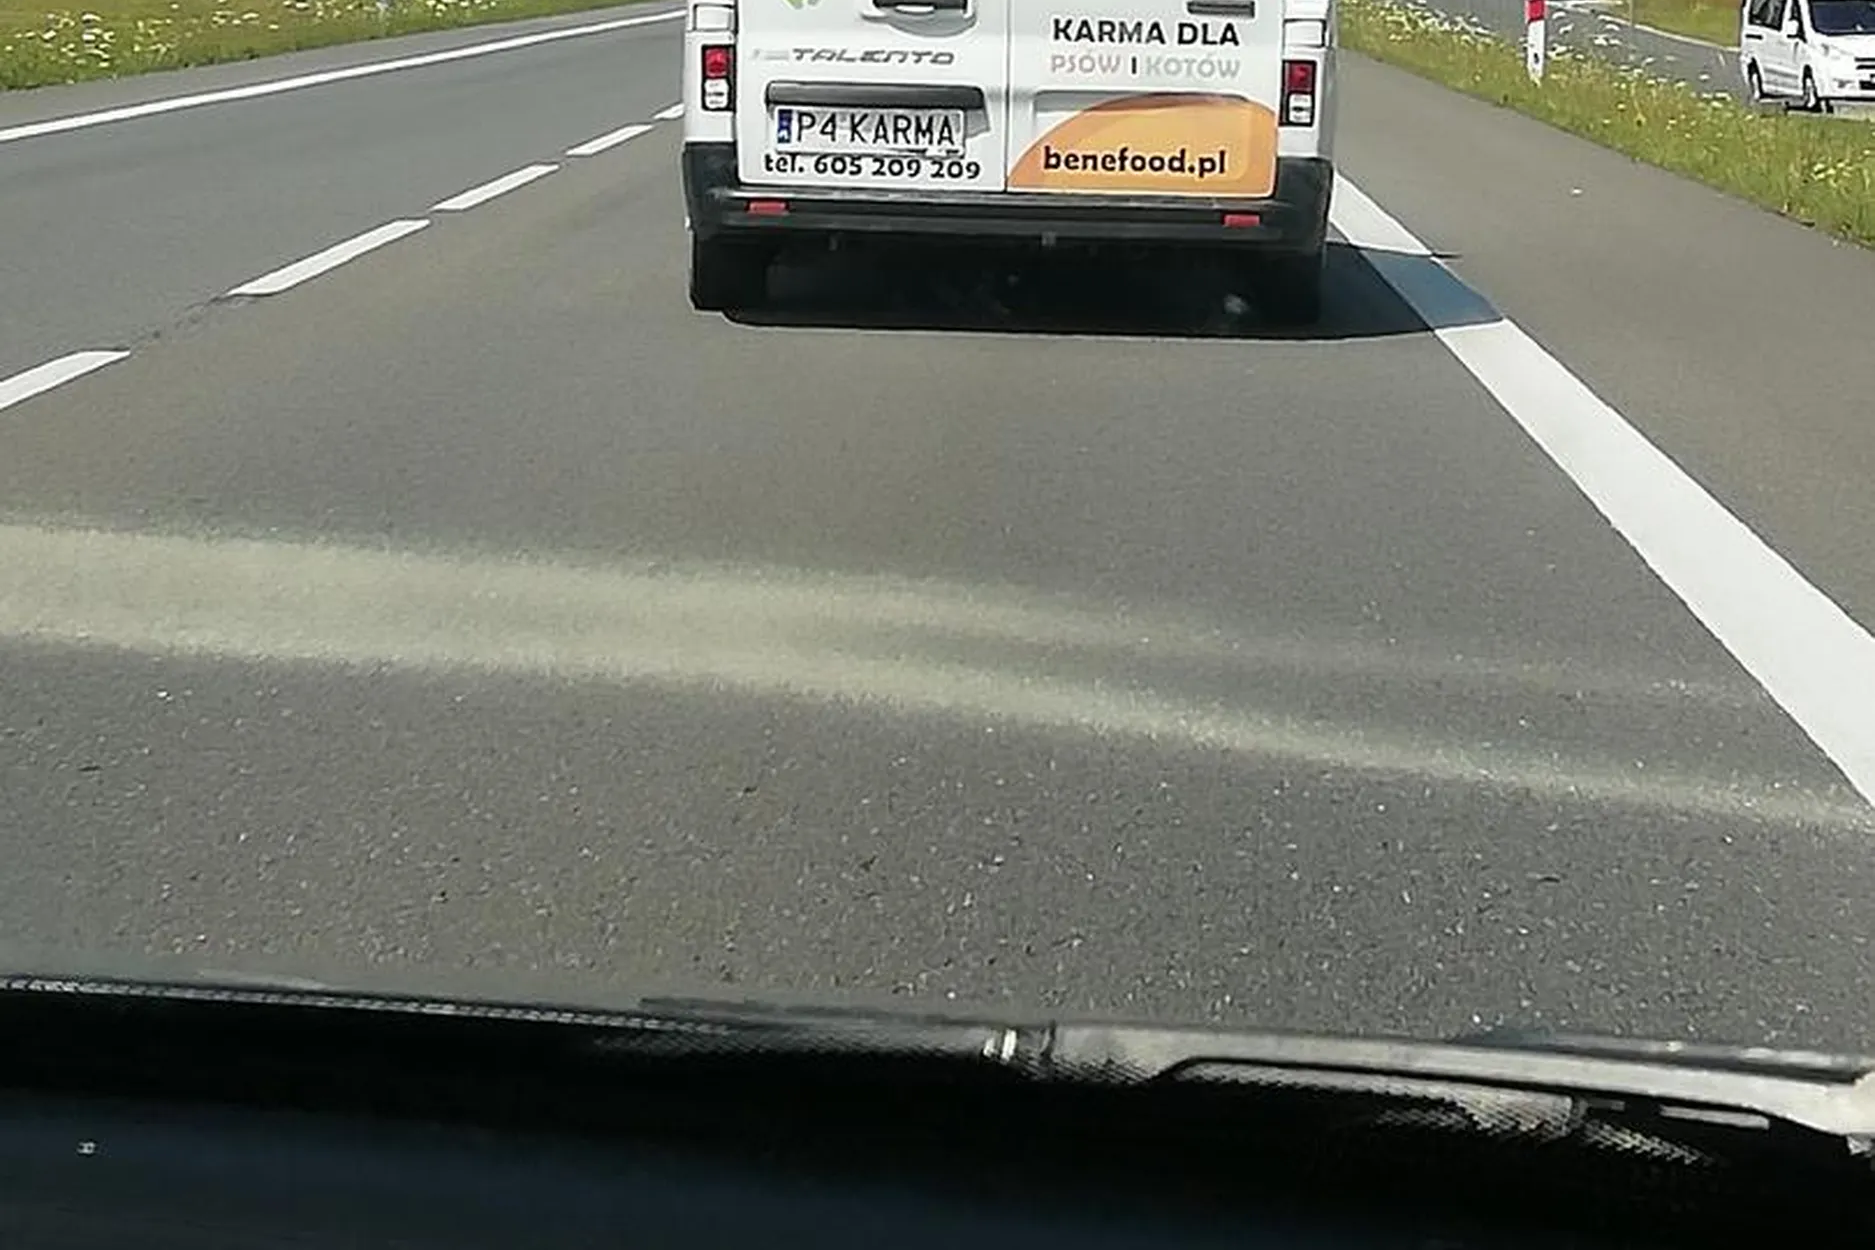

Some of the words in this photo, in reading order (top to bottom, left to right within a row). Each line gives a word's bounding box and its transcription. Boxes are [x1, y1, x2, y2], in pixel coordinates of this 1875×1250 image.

[1053, 18, 1166, 45] KARMA
[1177, 22, 1240, 47] DLA
[1050, 51, 1121, 74] PSÓW
[1131, 56, 1138, 75] I
[1146, 53, 1241, 79] KOTÓW
[797, 112, 836, 142] P4
[849, 113, 955, 146] KARMA
[764, 153, 805, 173] tel.
[813, 155, 863, 176] 605
[872, 158, 922, 178] 209
[929, 160, 981, 180] 209
[1042, 145, 1227, 179] benefood.pl
